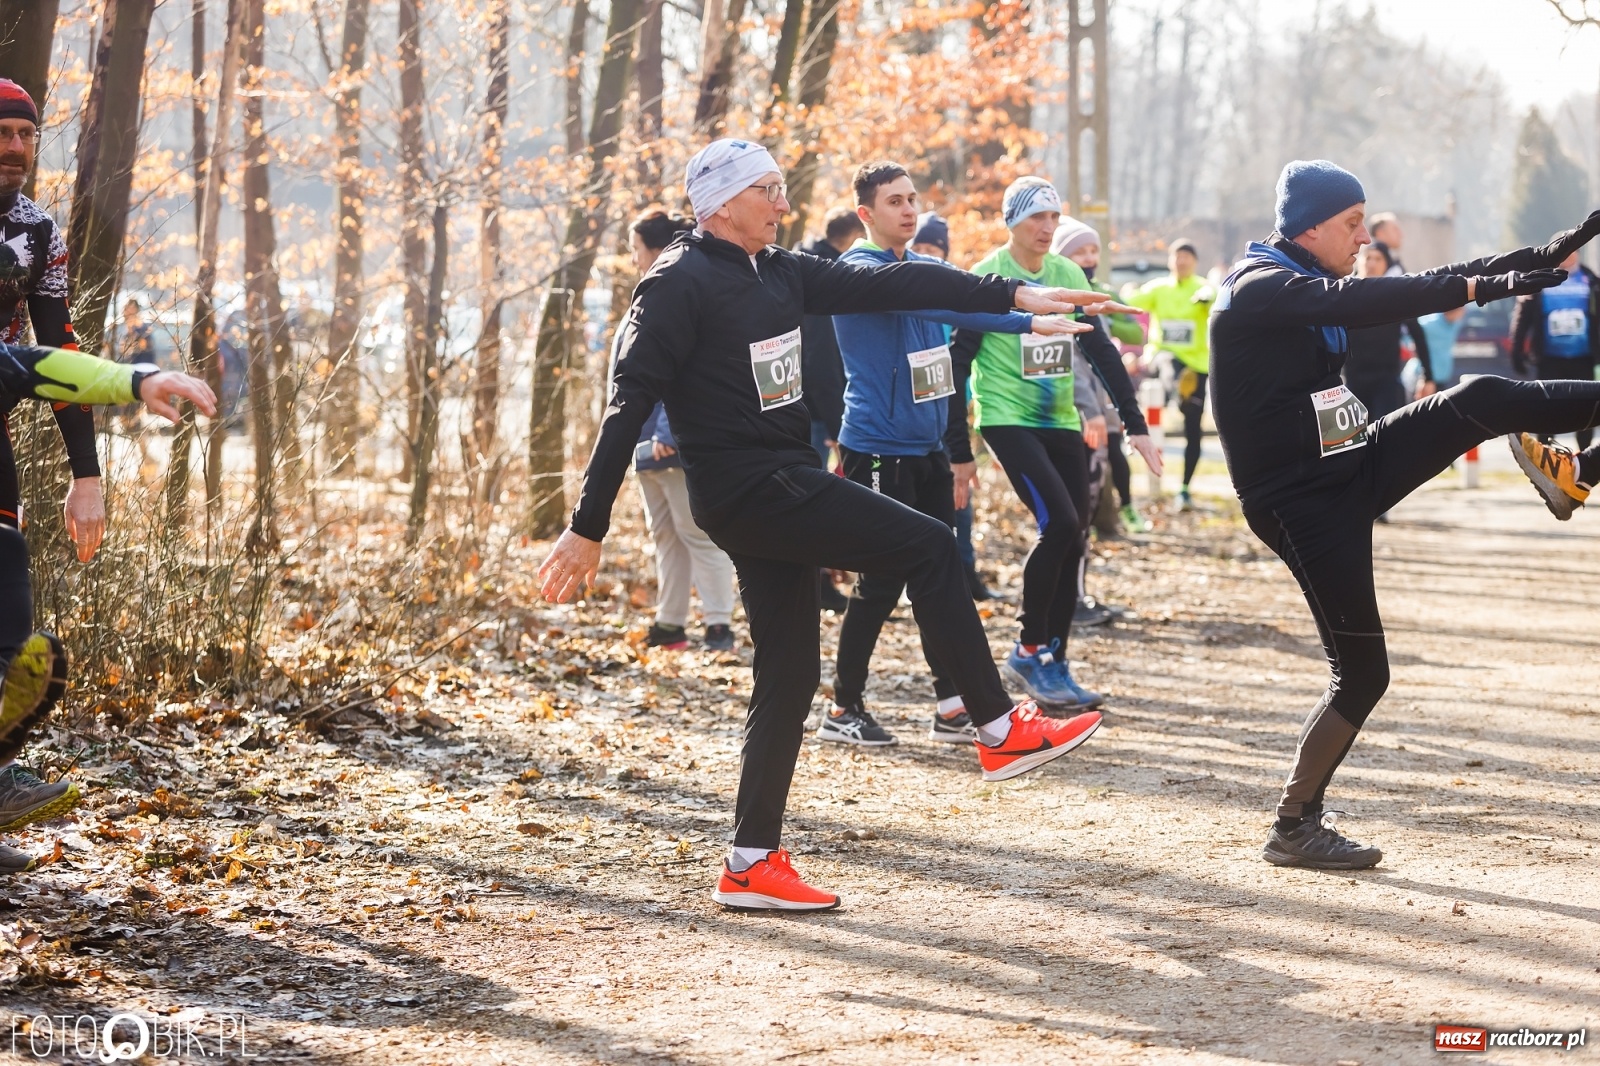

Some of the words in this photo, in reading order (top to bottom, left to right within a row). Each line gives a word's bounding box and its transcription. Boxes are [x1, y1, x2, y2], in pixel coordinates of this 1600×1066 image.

[766, 341, 780, 350] BIEG
[1032, 345, 1064, 365] 027
[770, 354, 800, 385] 024
[924, 363, 945, 386] 119
[1327, 389, 1341, 399] BIEG
[1335, 402, 1365, 430] 012
